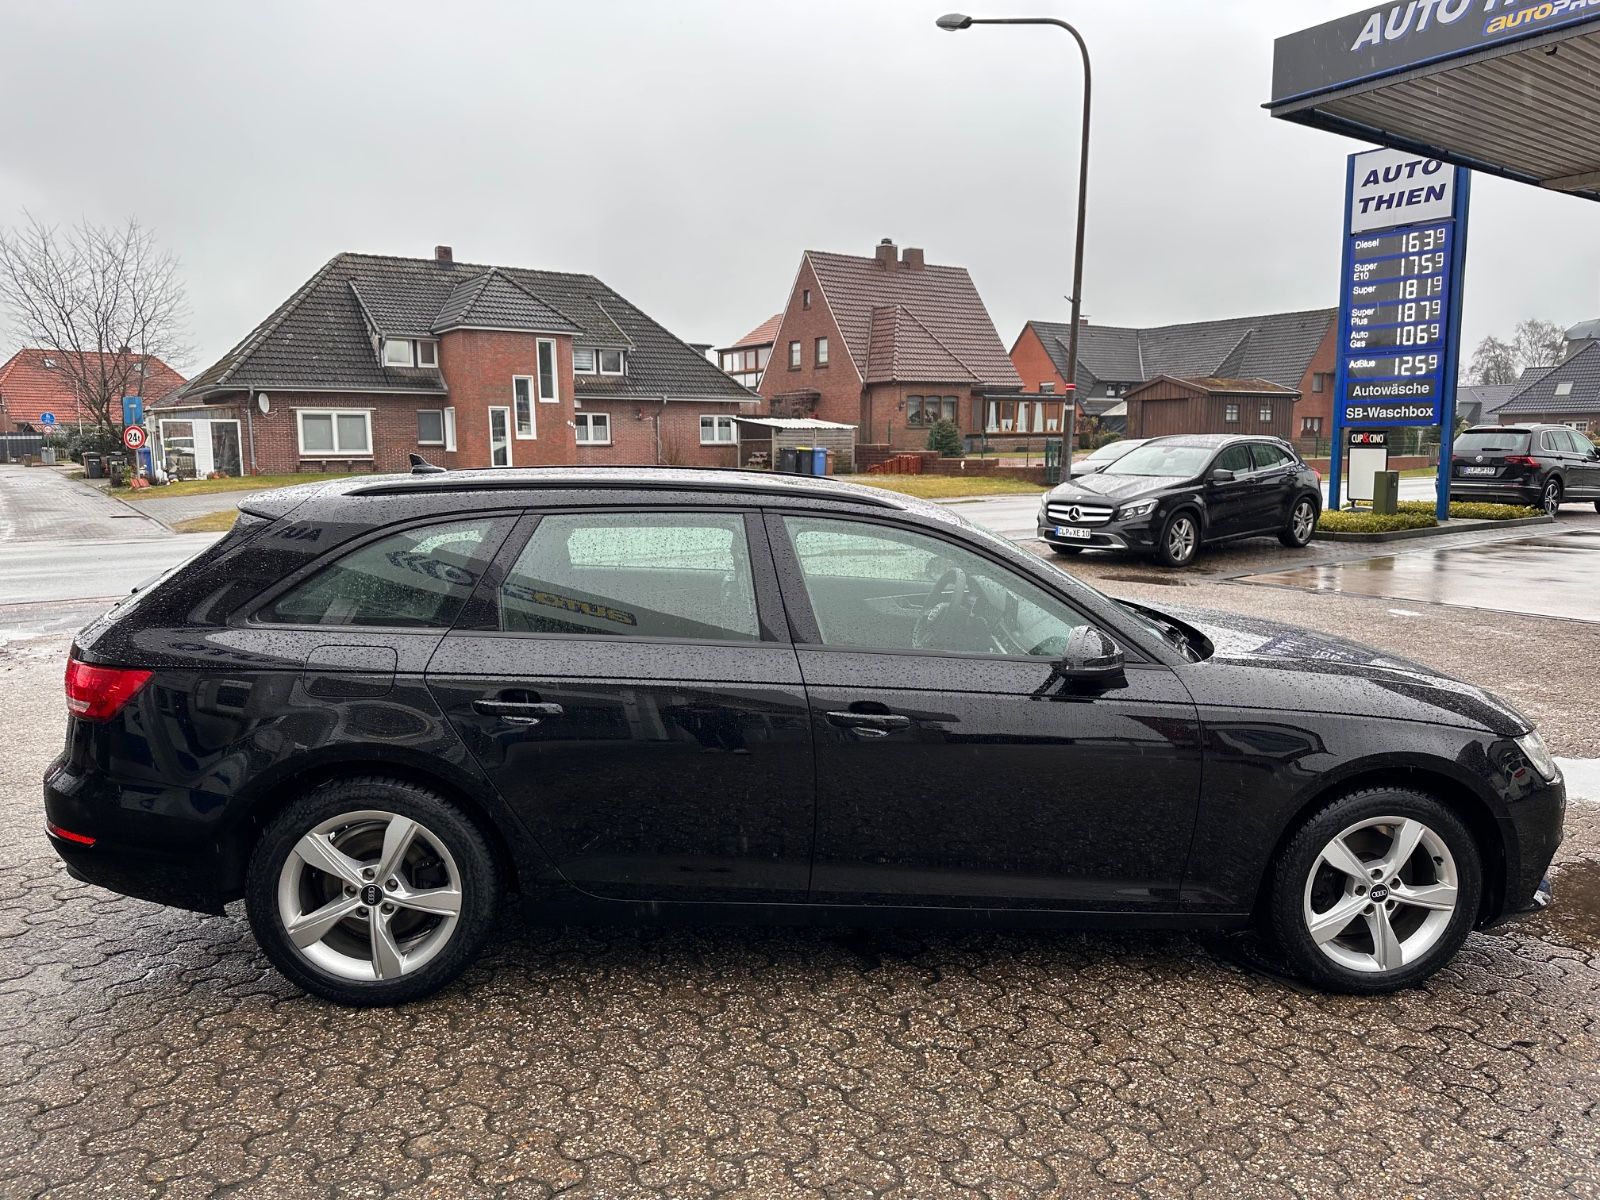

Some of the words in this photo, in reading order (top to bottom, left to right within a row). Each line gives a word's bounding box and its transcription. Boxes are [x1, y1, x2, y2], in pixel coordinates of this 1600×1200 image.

[1350, 0, 1468, 51] AUTO
[1361, 158, 1443, 188] AUTO
[1358, 183, 1447, 214] THIEN
[1355, 238, 1380, 249] Diesel
[1354, 263, 1378, 273] Super
[1353, 271, 1369, 281] E10
[1353, 286, 1376, 296] Super
[1351, 307, 1375, 317] Super
[1351, 316, 1368, 326] Plus
[1350, 330, 1369, 339] Auto
[1349, 339, 1366, 349] Gas
[1349, 358, 1376, 369] AdBlue
[1352, 382, 1430, 397] Autowäsche
[1346, 406, 1434, 420] SB-Waschbox
